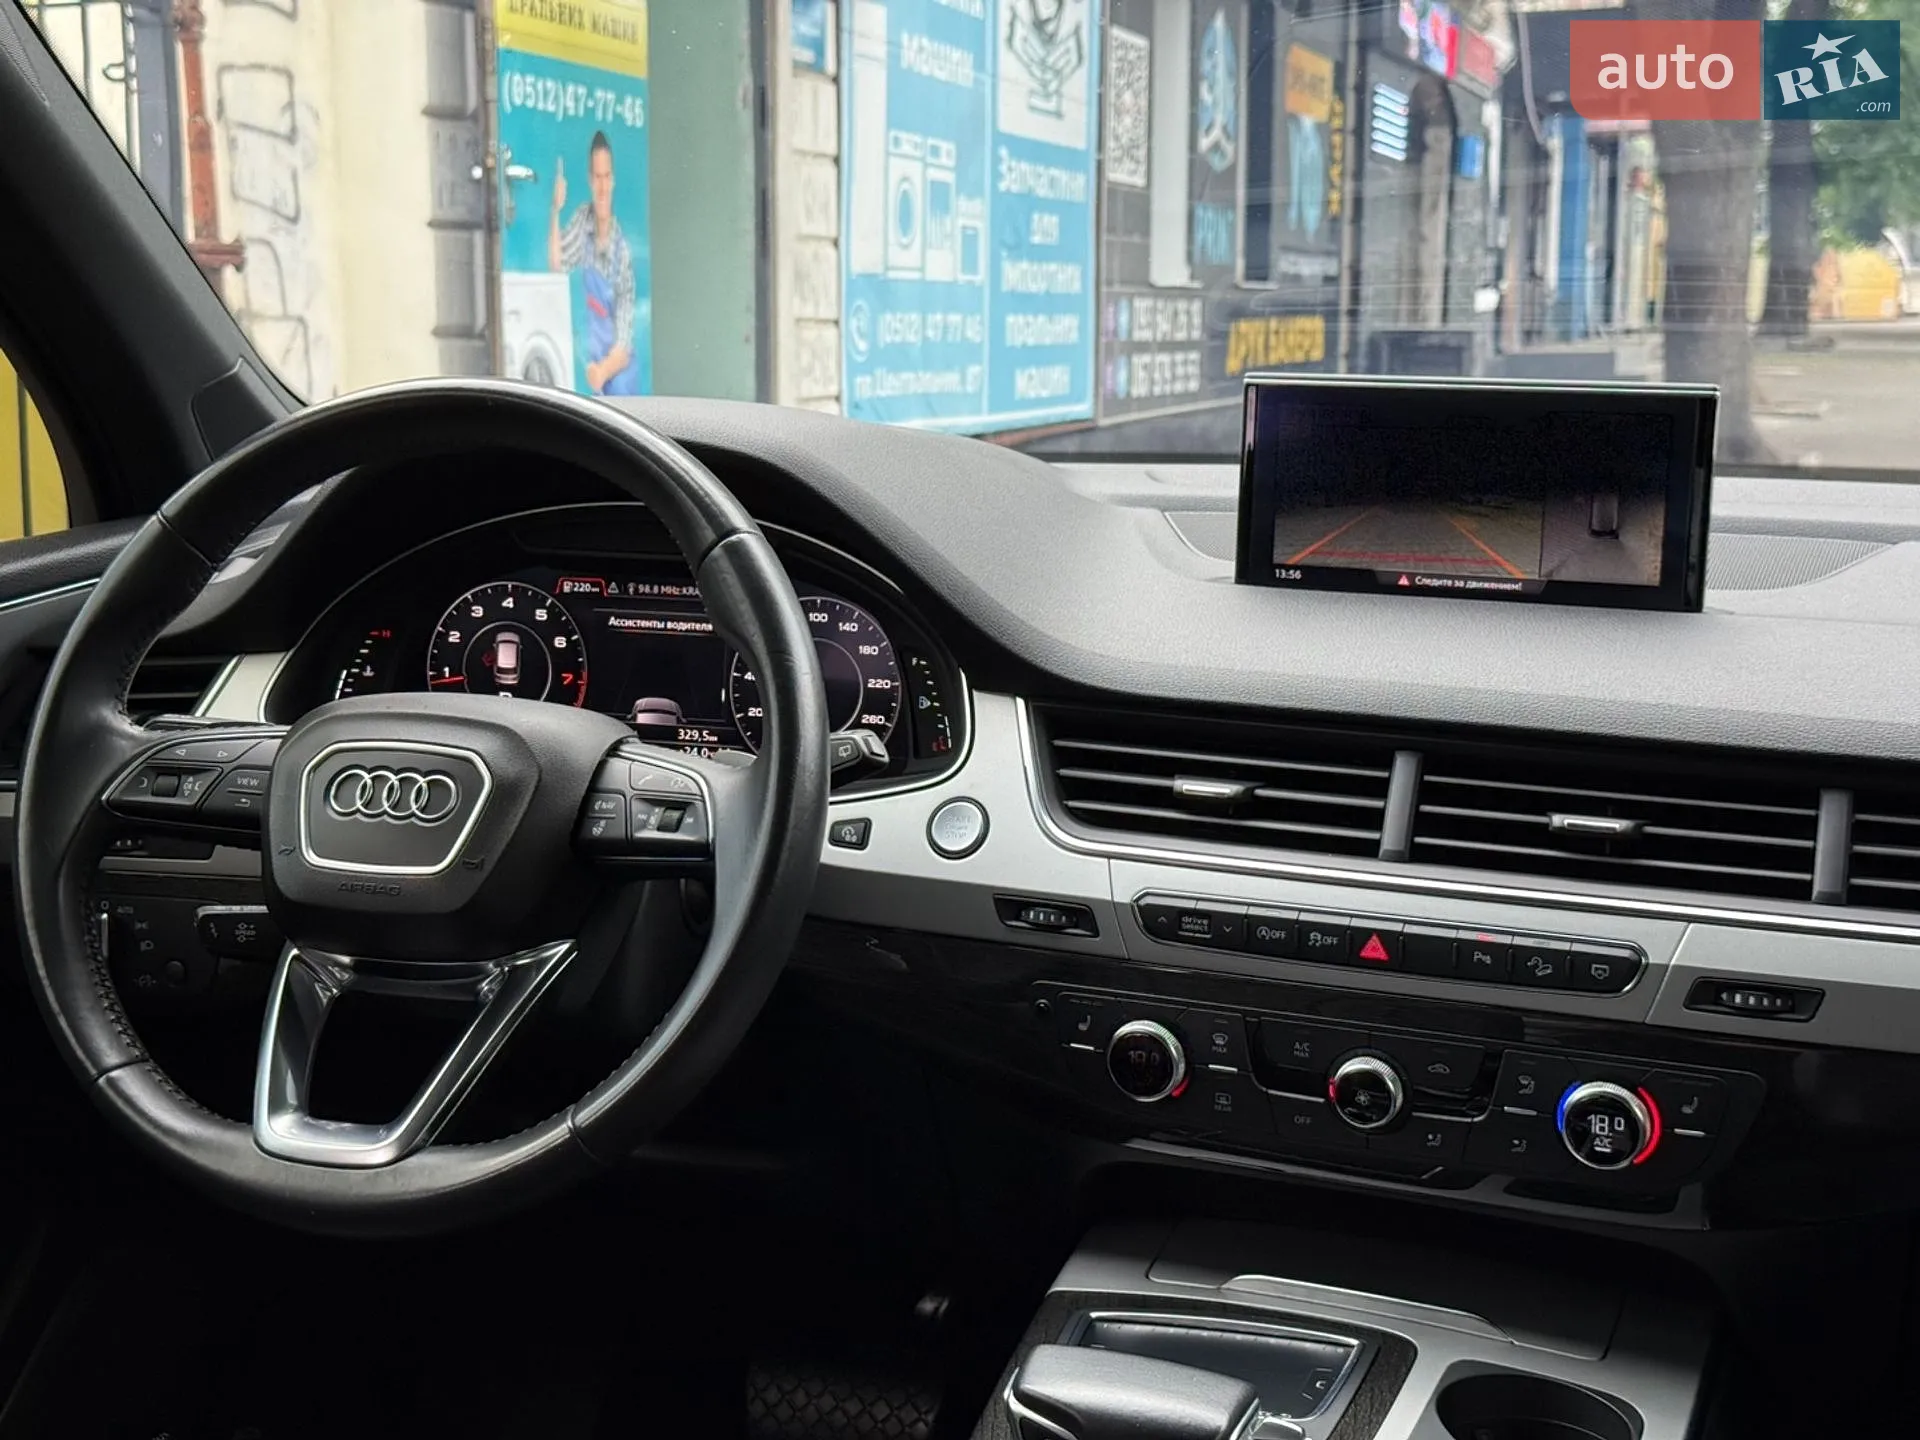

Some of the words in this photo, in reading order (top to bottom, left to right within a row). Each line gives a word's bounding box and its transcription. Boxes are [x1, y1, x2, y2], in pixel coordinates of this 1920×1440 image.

[1274, 568, 1302, 580] 13:56
[1414, 576, 1453, 588] Следите
[1454, 579, 1465, 588] за
[1466, 580, 1523, 591] движением!
[502, 597, 515, 608] 4
[471, 606, 484, 618] 3
[535, 609, 548, 621] 5
[608, 616, 665, 629] Ассистенты
[666, 621, 714, 631] водителя
[808, 612, 829, 624] 100
[838, 622, 859, 633] 140
[448, 631, 462, 643] 2
[554, 637, 567, 648] 6
[858, 645, 879, 656] 180
[443, 666, 450, 677] 1
[561, 674, 574, 685] 7
[867, 678, 892, 689] 220
[861, 714, 886, 725] 260
[236, 776, 260, 787] VIEW
[337, 880, 402, 897] AIRBAG
[1181, 916, 1209, 926] drive
[1270, 930, 1287, 940] OFF
[1322, 936, 1339, 945] OFF
[1294, 1042, 1310, 1052] A/C
[1294, 1115, 1312, 1125] OFF
